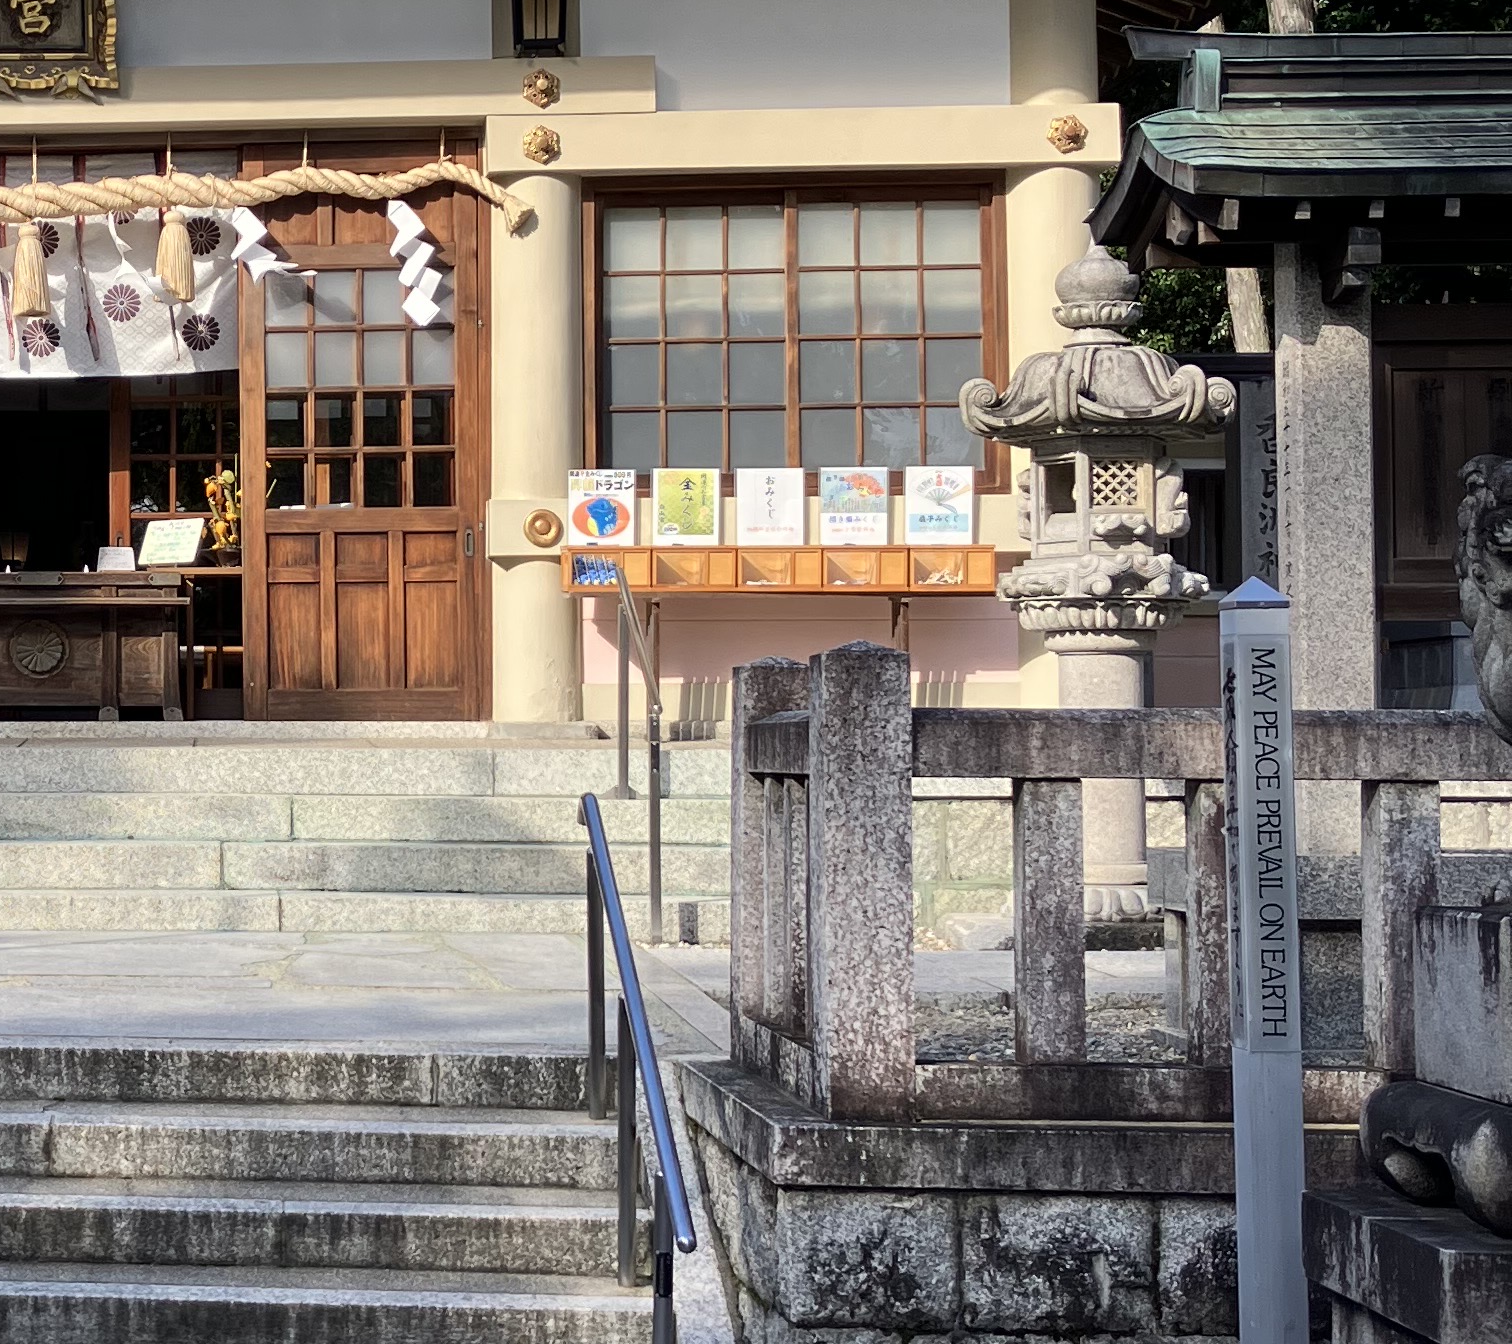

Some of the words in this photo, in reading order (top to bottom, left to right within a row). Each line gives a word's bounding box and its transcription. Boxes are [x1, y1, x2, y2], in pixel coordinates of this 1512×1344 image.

[765, 475, 775, 519] おみくじ
[1251, 647, 1278, 702] MAY
[1253, 710, 1281, 790] PEACE
[1256, 799, 1284, 898] PREVAIL
[1259, 903, 1285, 941] ON
[1261, 948, 1287, 1037] EARTH
